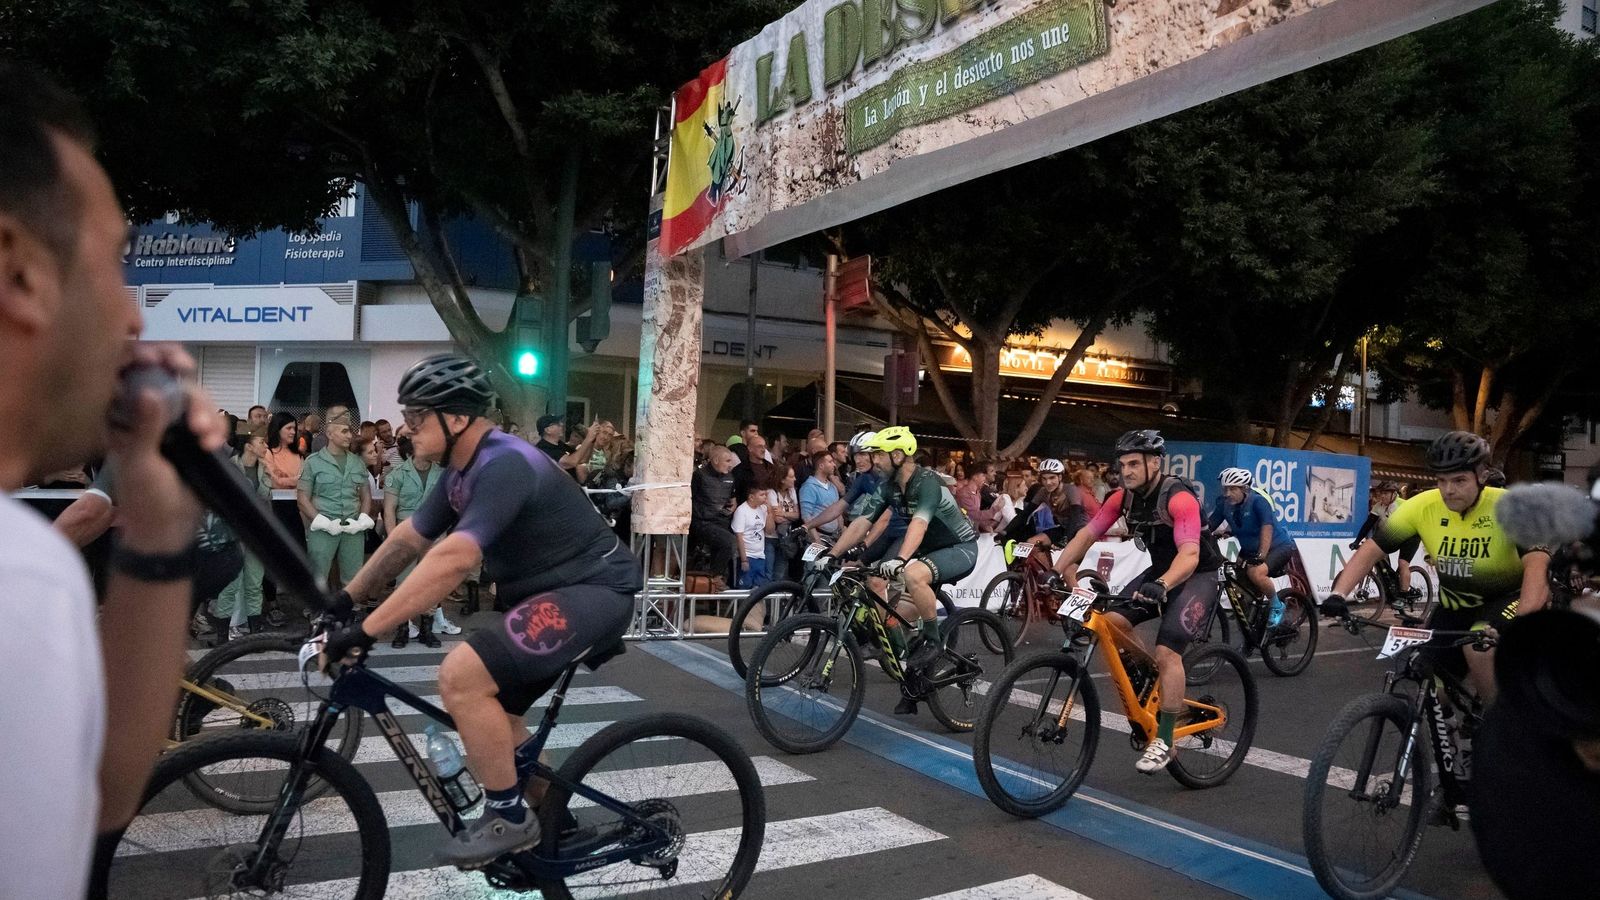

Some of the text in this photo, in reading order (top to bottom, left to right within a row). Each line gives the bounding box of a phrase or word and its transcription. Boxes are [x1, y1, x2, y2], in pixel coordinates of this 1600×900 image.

[756, 31, 812, 128] LA
[863, 106, 878, 128] La
[918, 84, 928, 107] y
[935, 73, 948, 97] el
[953, 51, 1004, 91] desierto
[1010, 37, 1035, 66] nos
[1041, 22, 1070, 50] une
[135, 255, 235, 268] Centro Interdisciplinar
[285, 247, 344, 261] Fisioterapia
[177, 306, 313, 323] VITALDENT
[1256, 458, 1298, 493] gar
[1275, 492, 1300, 523] sa
[1437, 536, 1491, 558] ALBOX
[1437, 556, 1475, 577] BIKE
